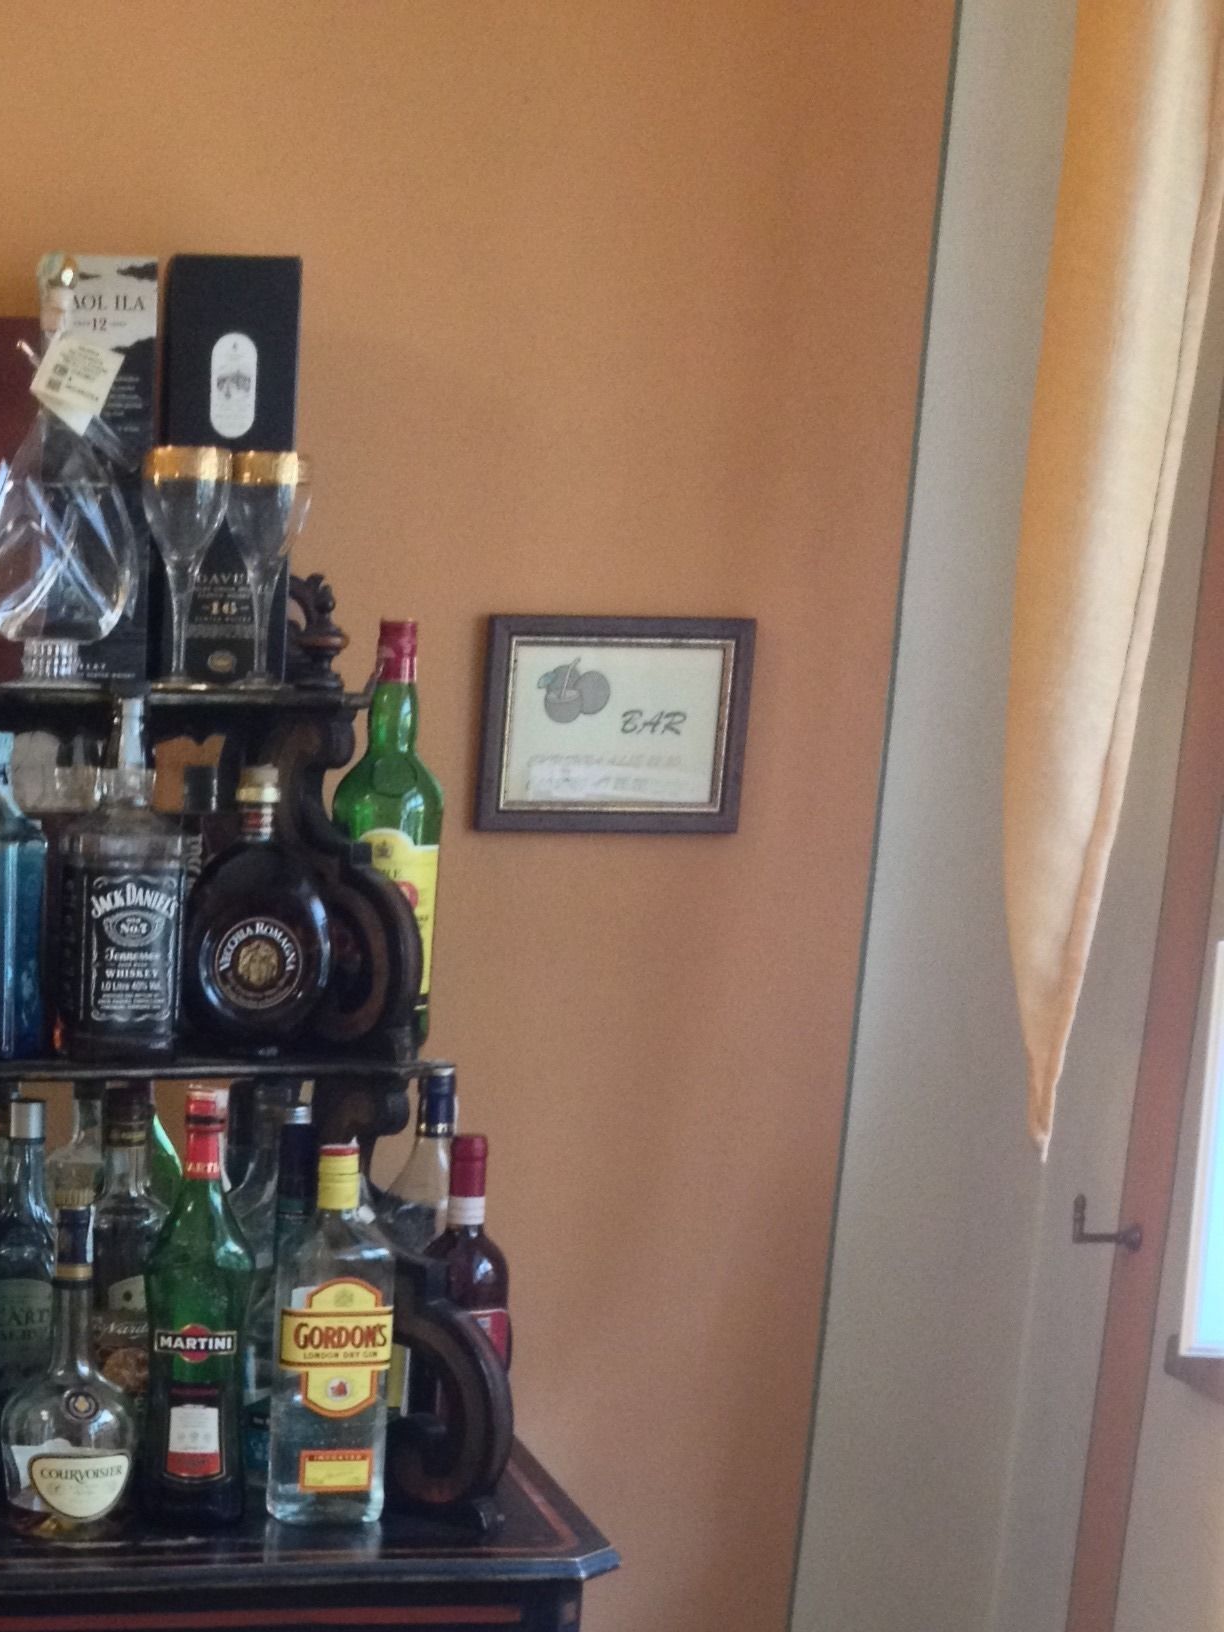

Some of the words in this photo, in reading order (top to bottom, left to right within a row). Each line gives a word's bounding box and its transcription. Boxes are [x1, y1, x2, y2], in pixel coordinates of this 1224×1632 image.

[115, 294, 146, 312] ILA
[91, 316, 107, 332] 12
[620, 708, 687, 736] BAR
[90, 887, 125, 919] JACK
[126, 882, 179, 920] DANIEL'S
[255, 921, 296, 972] ROMAGNA
[104, 968, 159, 979] WHISKEY
[159, 1333, 234, 1352] MARTINI
[293, 1321, 388, 1350] GORDON'S
[302, 1351, 340, 1361] LONDON
[342, 1351, 360, 1360] DRY
[39, 1464, 123, 1485] COURVOISIER
